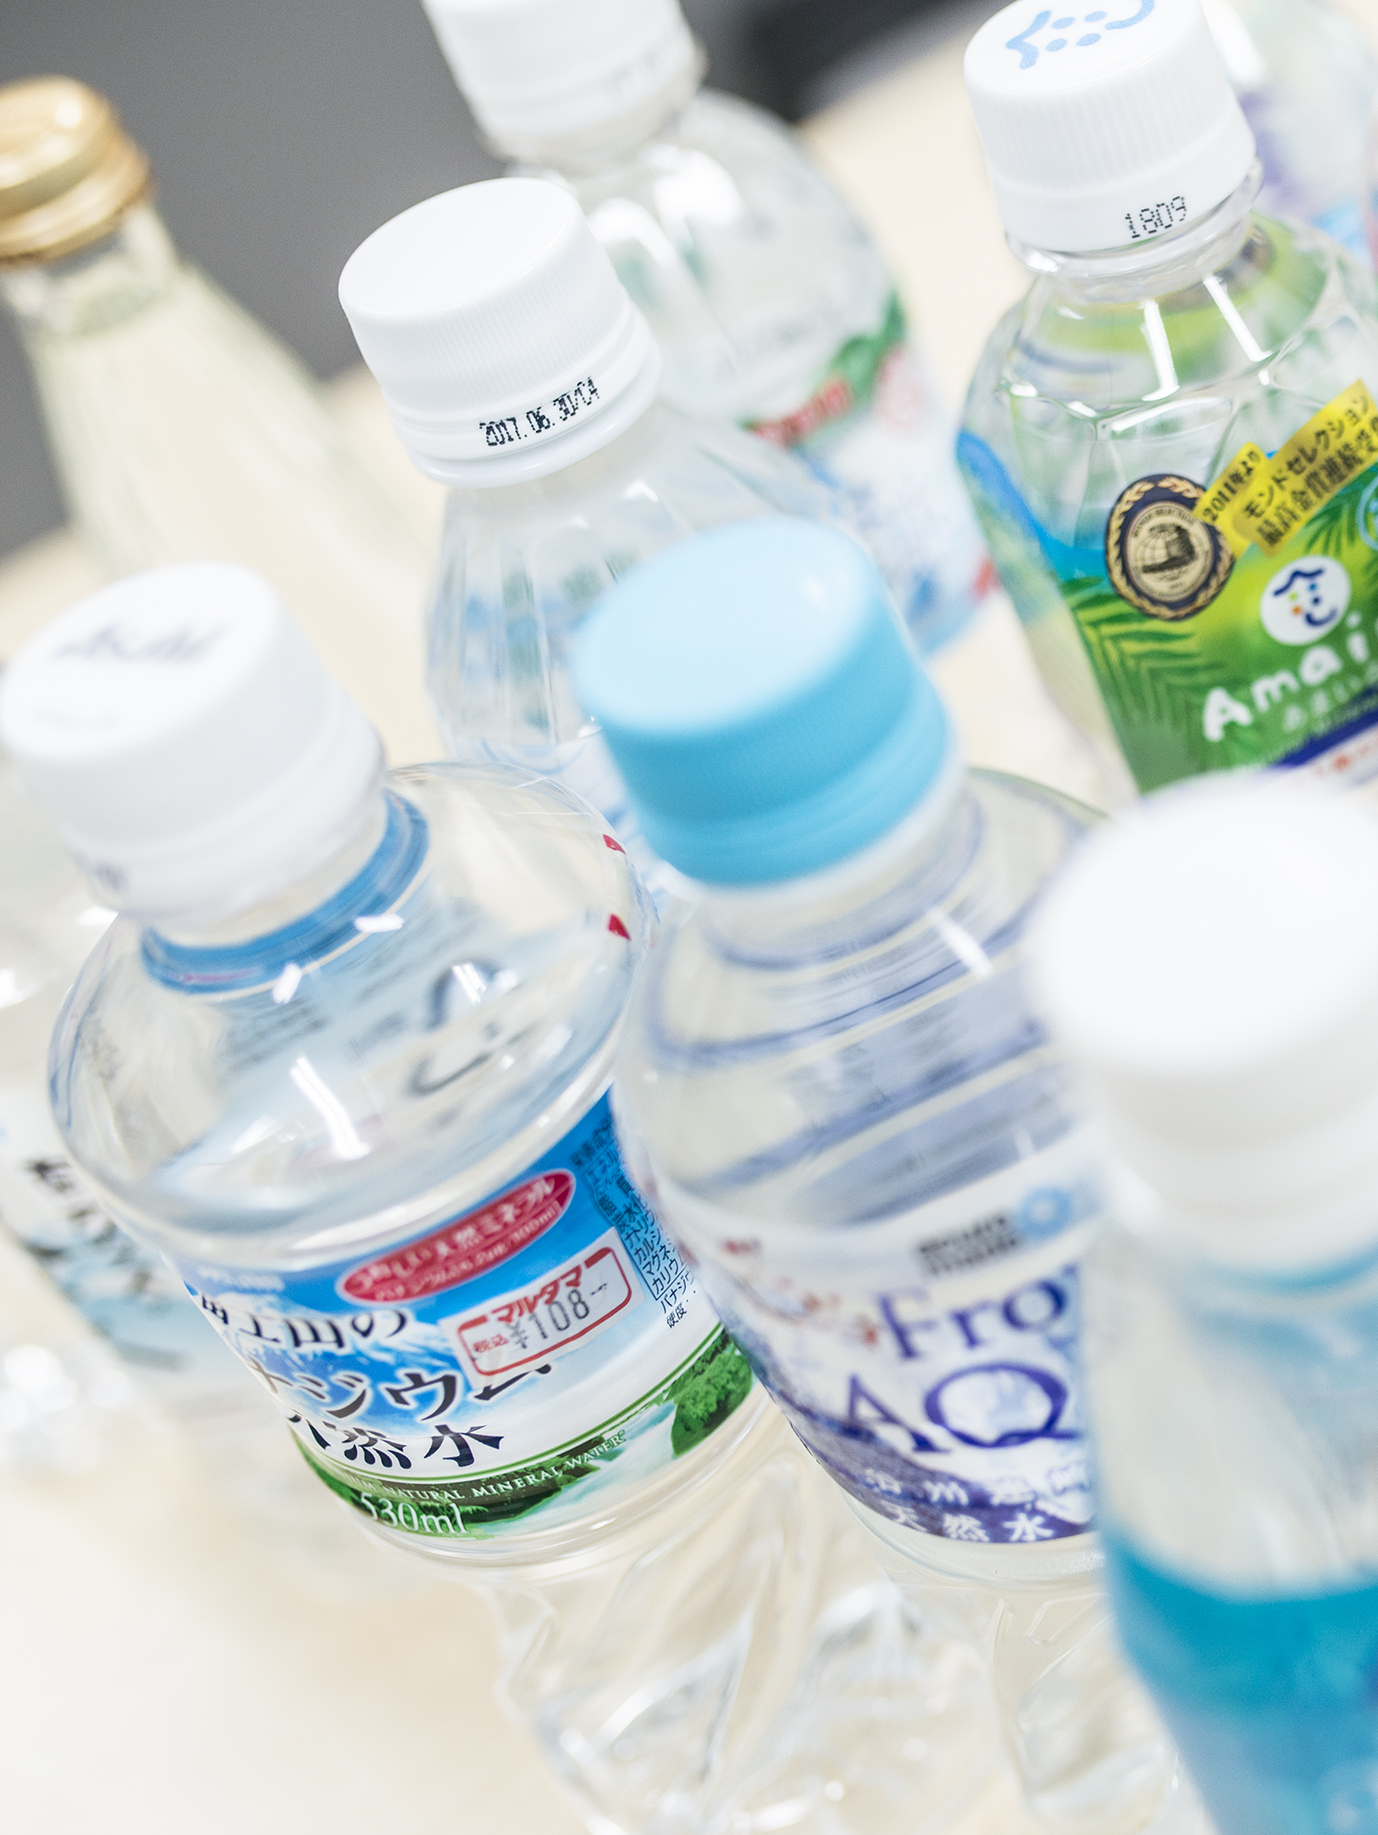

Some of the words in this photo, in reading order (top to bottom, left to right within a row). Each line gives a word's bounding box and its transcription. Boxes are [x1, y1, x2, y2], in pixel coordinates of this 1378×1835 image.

[1125, 196, 1187, 238] 1809
[1244, 393, 1370, 519] モンドセレクション
[875, 1276, 1067, 1361] Fro
[838, 1359, 1081, 1455] AQ
[359, 1491, 468, 1535] 530ml
[383, 1484, 466, 1502] NATURAL
[472, 1465, 564, 1499] MINERAL
